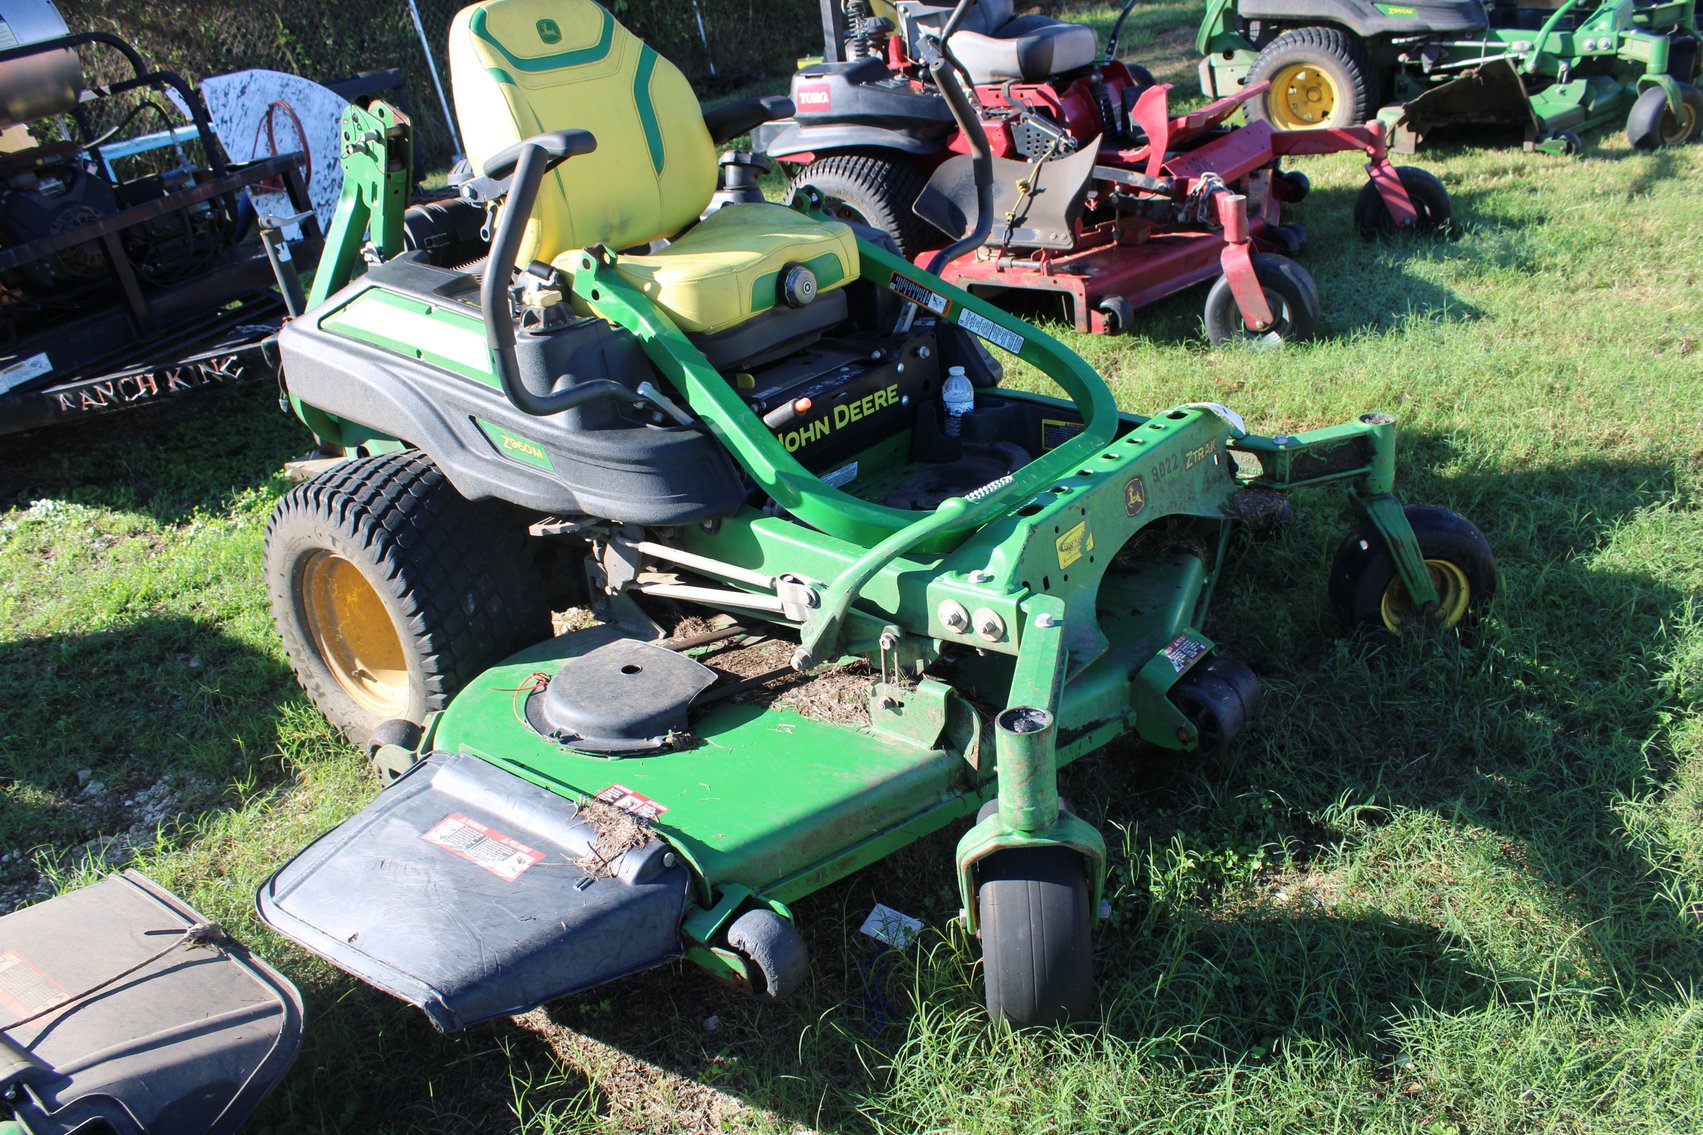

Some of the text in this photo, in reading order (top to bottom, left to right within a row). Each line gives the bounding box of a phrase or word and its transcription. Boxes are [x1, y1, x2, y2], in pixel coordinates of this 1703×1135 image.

[56, 373, 158, 412] RANCH
[165, 354, 244, 392] KING
[833, 384, 899, 430] DEERE
[500, 434, 544, 459] Z960M
[1185, 438, 1217, 469] ZTRAK
[1151, 453, 1178, 483] 9022
